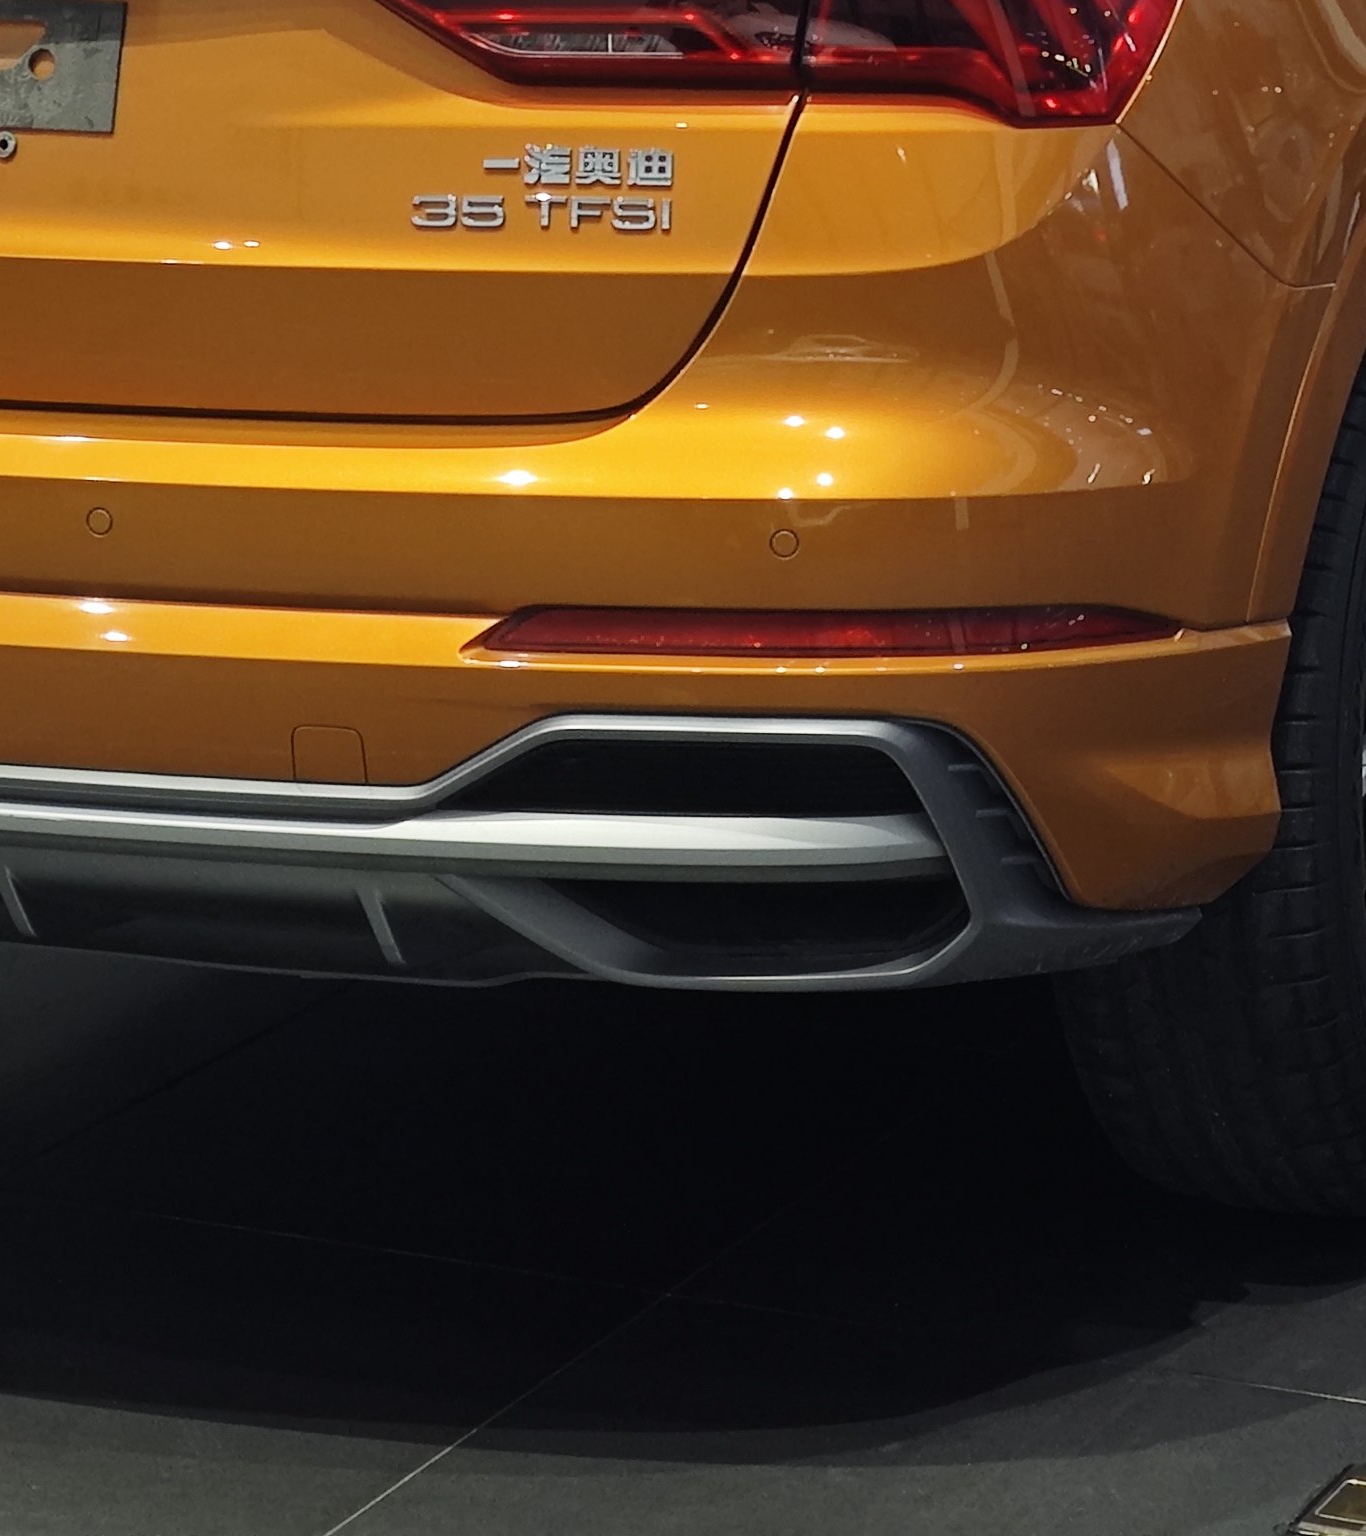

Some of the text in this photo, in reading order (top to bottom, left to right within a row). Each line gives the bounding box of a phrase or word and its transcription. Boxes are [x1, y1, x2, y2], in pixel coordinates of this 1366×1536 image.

[483, 143, 674, 186] 一汽奥迪
[410, 193, 672, 232] 35 TFSI
